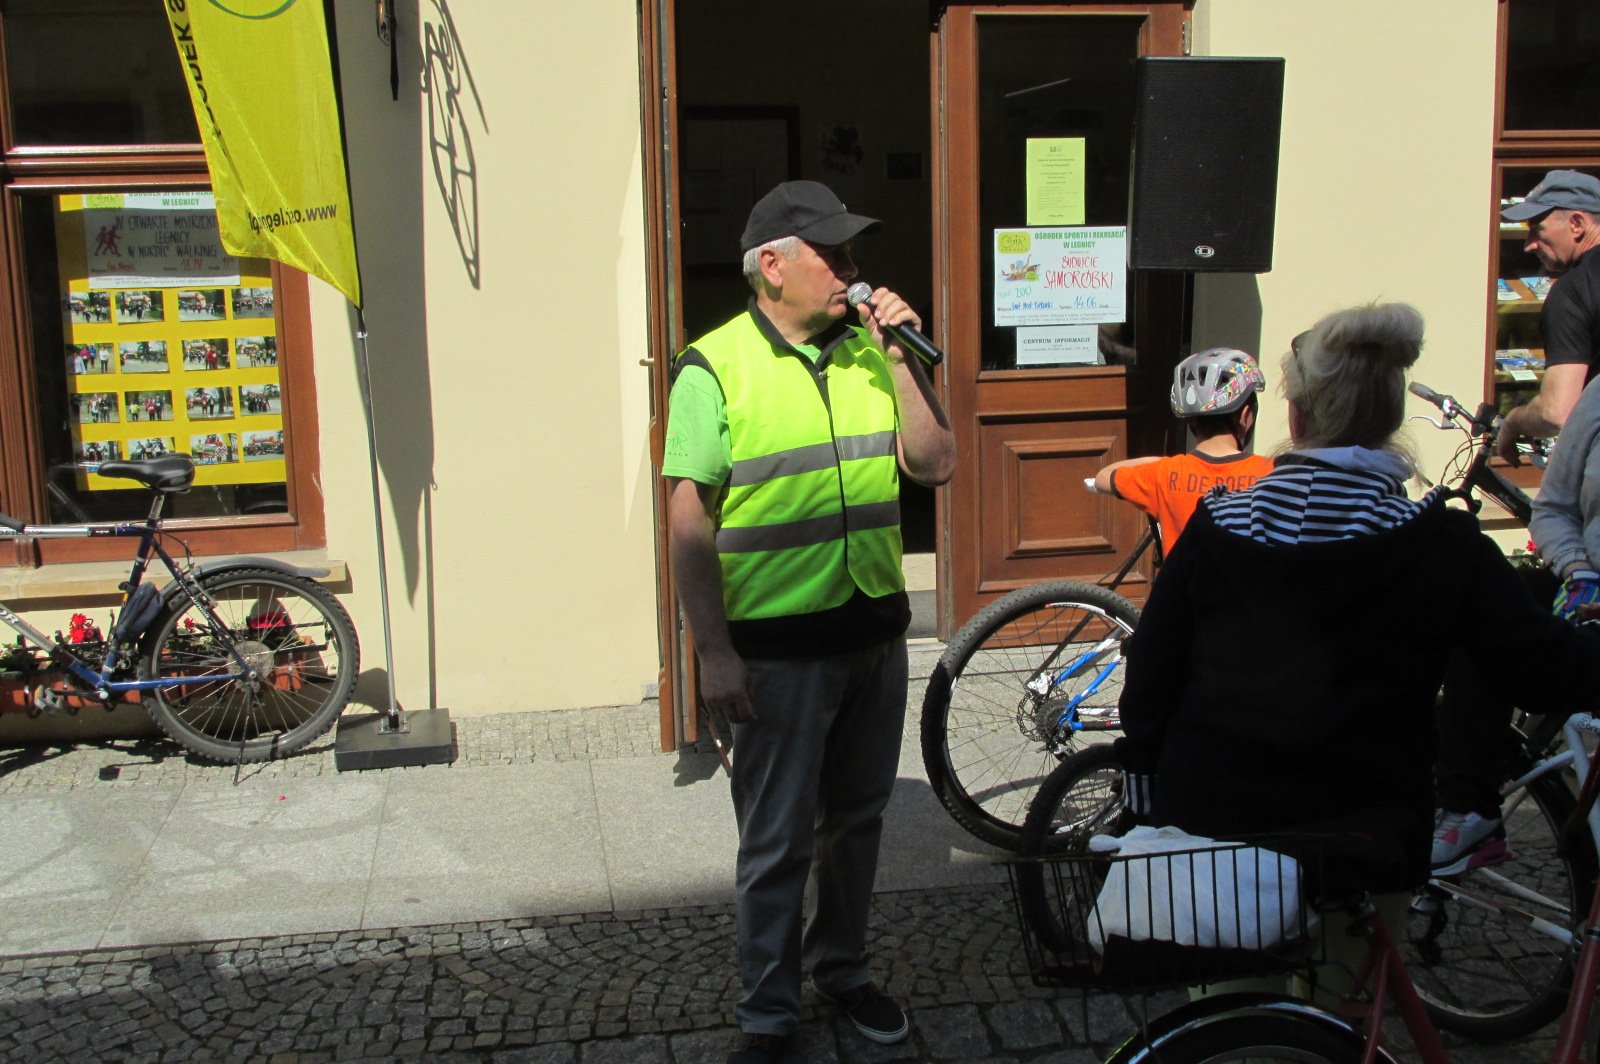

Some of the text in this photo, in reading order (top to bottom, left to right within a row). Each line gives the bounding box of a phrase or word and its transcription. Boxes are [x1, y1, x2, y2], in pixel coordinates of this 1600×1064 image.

[162, 198, 200, 206] W LEGNICY
[1064, 231, 1088, 239] SPORTU
[1063, 241, 1070, 249] W
[1169, 472, 1181, 491] R.
[1187, 473, 1209, 494] DE
